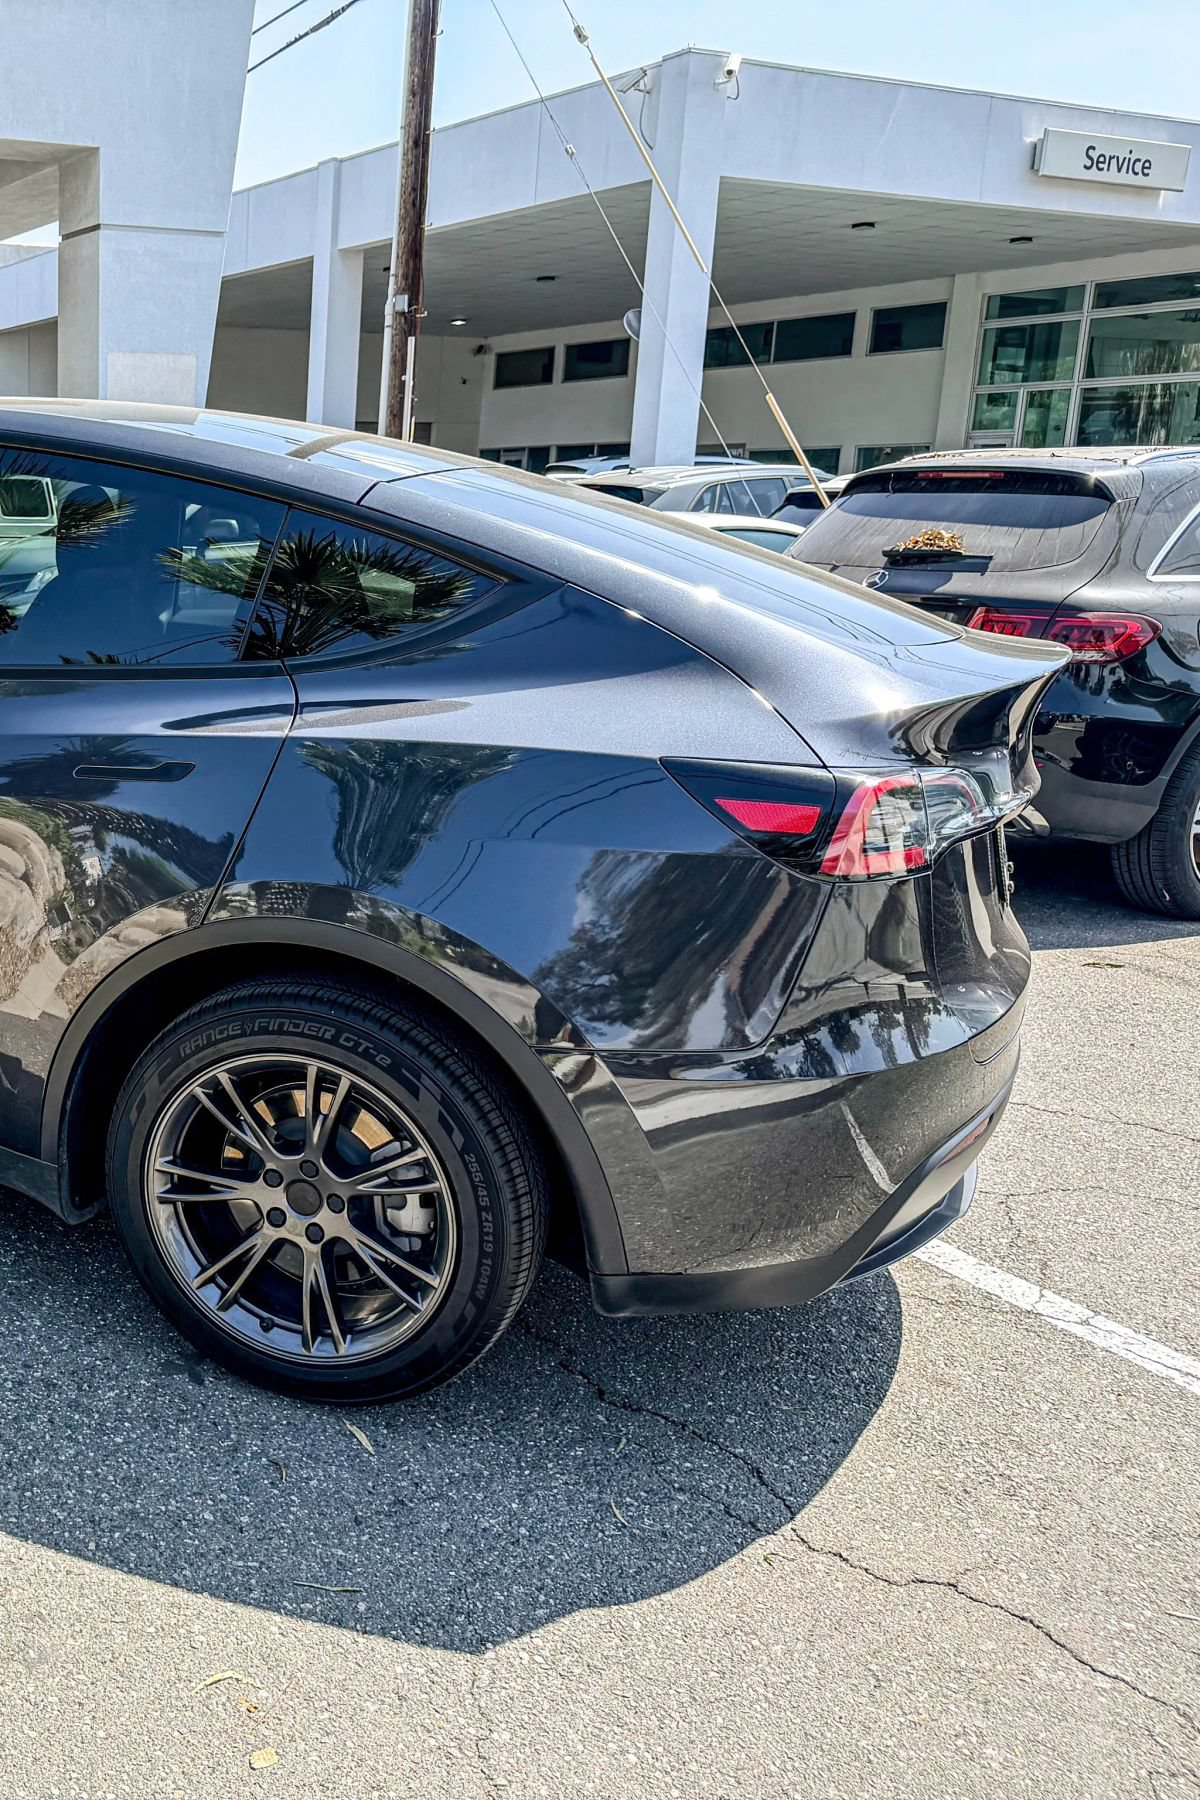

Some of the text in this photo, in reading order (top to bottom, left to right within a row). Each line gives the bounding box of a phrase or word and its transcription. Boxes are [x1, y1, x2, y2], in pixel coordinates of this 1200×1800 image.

[1083, 145, 1152, 177] Service
[179, 1019, 242, 1058] RANGE
[253, 1017, 336, 1040] FINDER
[464, 1152, 494, 1300] 255/45 ZR19 104W
